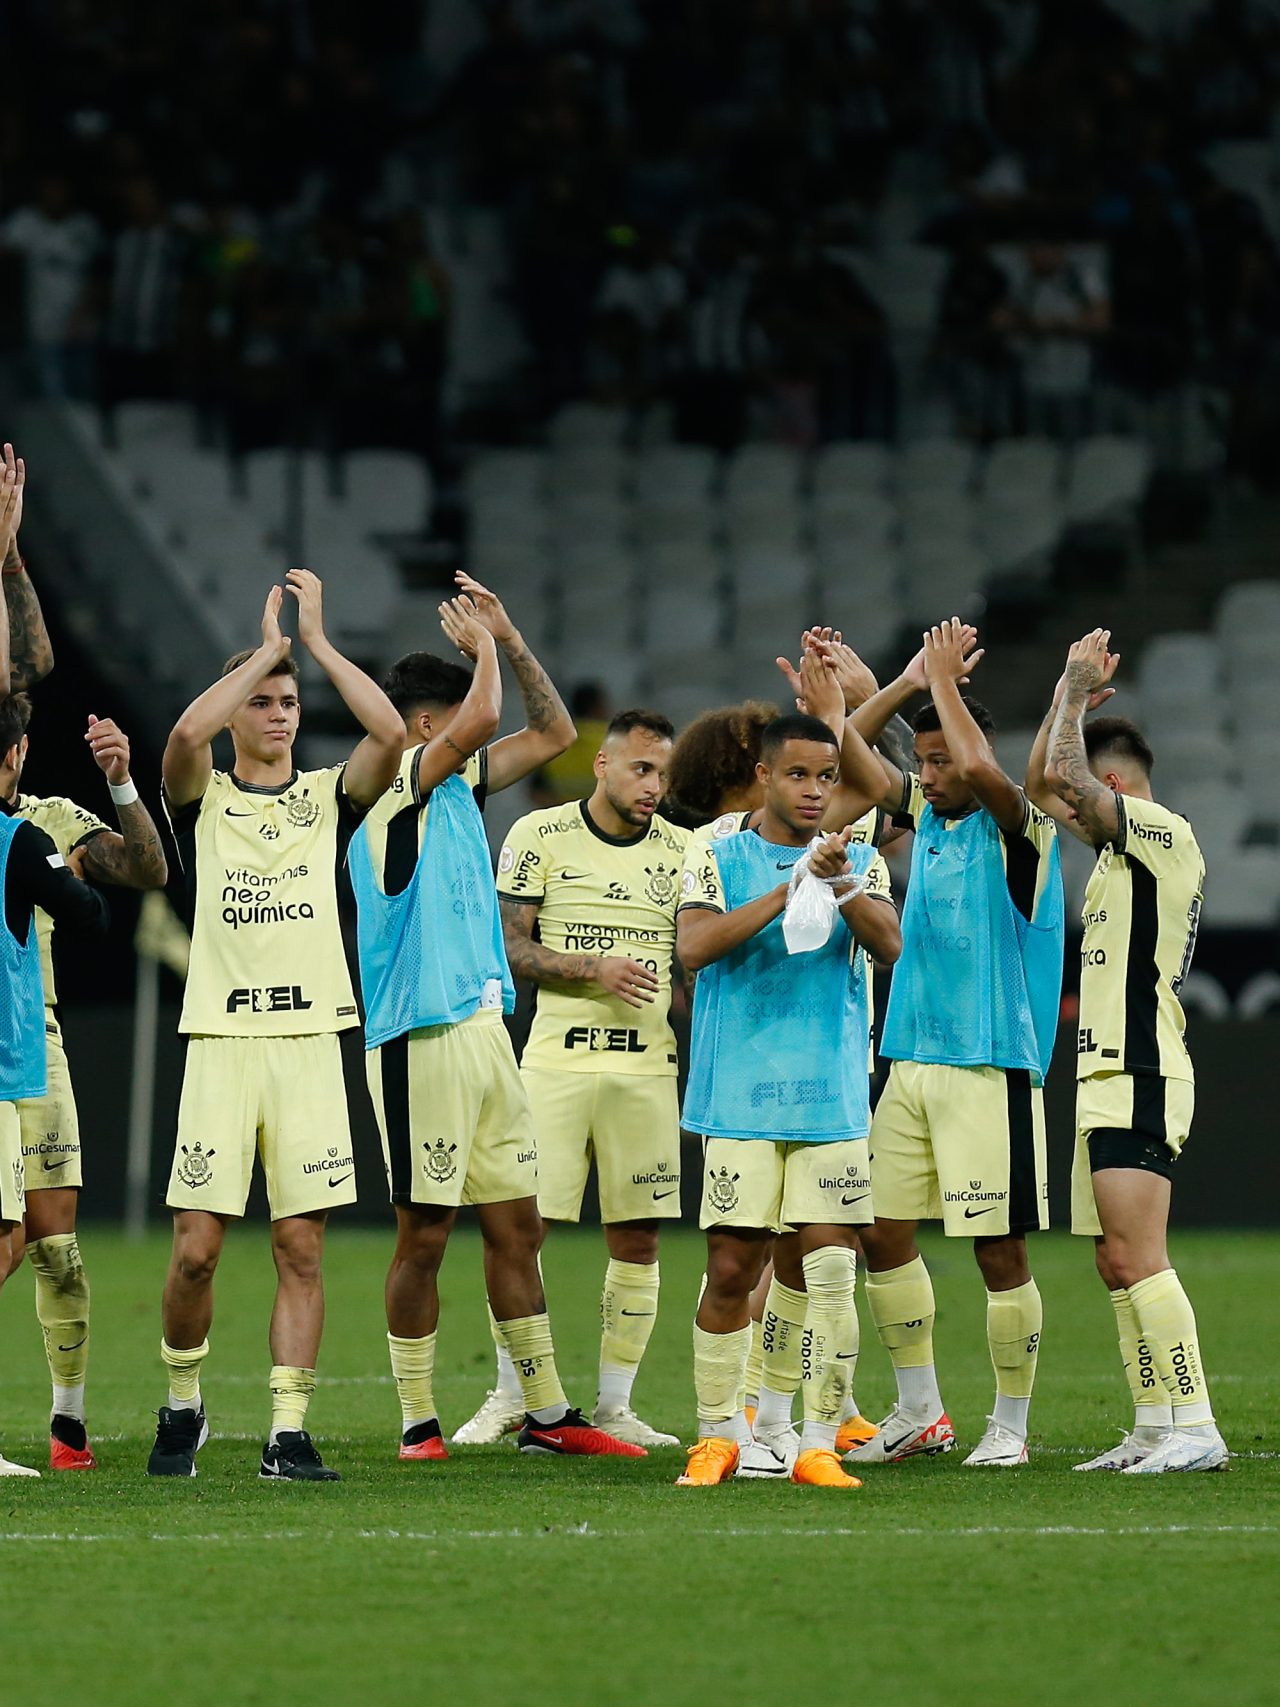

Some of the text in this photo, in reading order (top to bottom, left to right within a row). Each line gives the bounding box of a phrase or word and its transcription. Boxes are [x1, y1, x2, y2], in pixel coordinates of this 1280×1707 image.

[1139, 823, 1173, 849] bmg
[513, 850, 541, 884] bmg
[222, 886, 271, 904] neo
[603, 892, 632, 901] ALE
[222, 901, 314, 930] química
[565, 922, 659, 942] vitaminas
[565, 935, 615, 950] neo
[226, 986, 314, 1013] FIEL
[564, 1027, 648, 1053] FIEL
[21, 1143, 81, 1156] UniCesumar
[944, 1189, 1008, 1202] UniCesumar
[801, 1328, 814, 1381] TODOS
[816, 1335, 827, 1363] Cartão
[1169, 1341, 1195, 1396] TODOS
[1187, 1344, 1202, 1386] Cartão de
